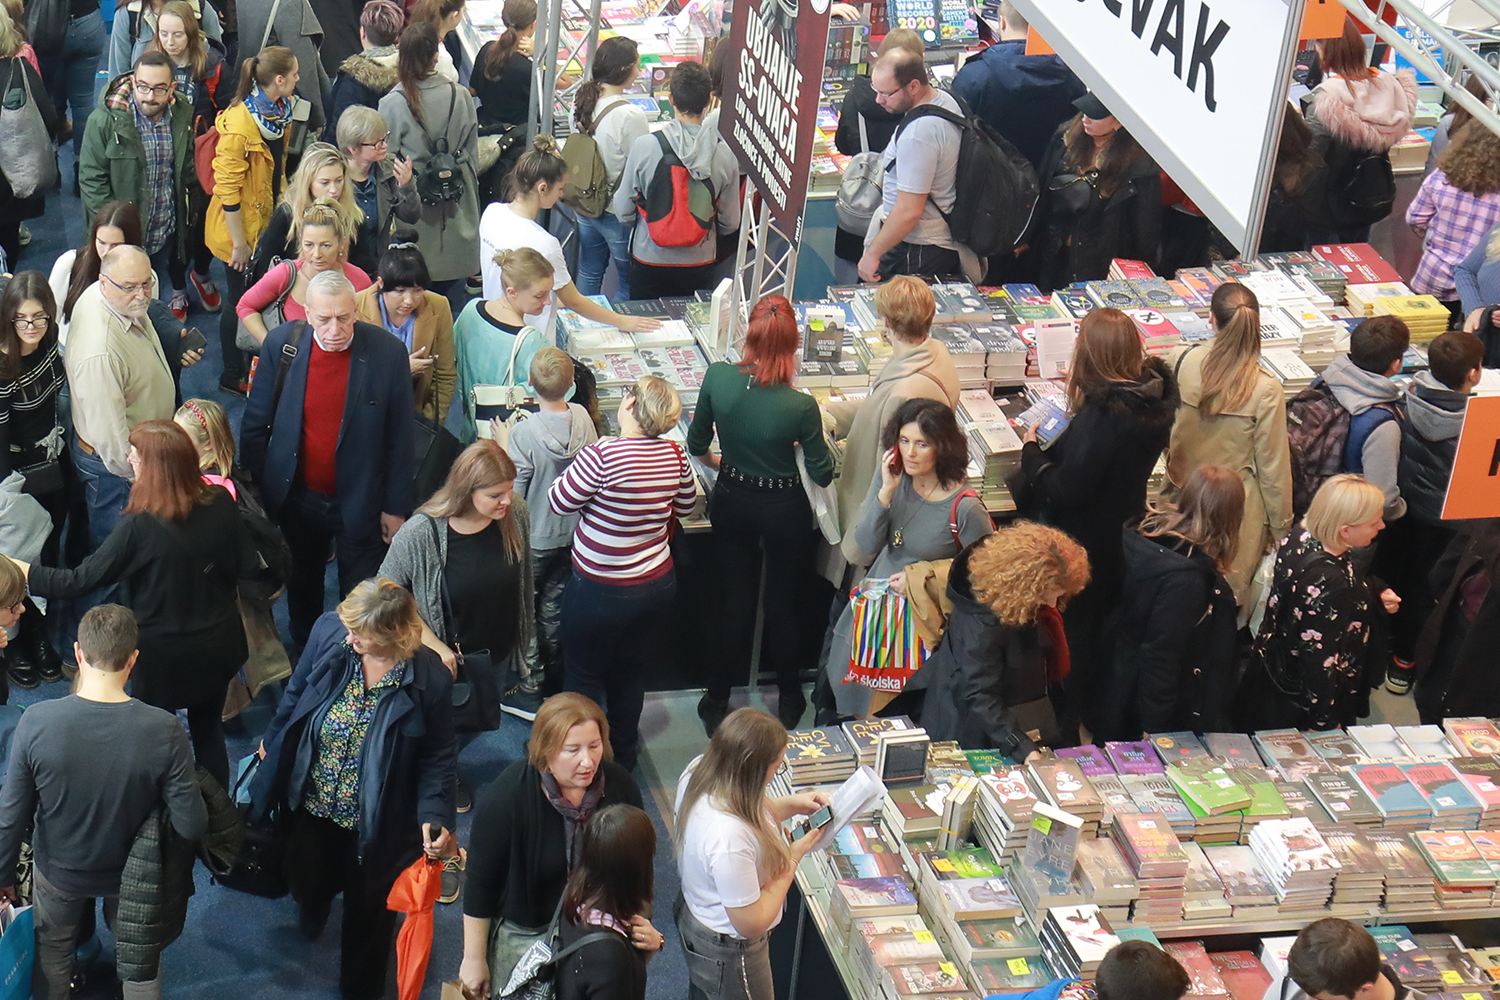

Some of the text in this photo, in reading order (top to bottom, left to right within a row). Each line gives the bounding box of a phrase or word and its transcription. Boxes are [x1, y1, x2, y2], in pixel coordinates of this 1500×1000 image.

[895, 2, 934, 11] WORLD
[896, 10, 935, 18] RECORDS
[897, 17, 936, 31] 2020
[745, 5, 803, 116] UBIJANJE
[738, 47, 798, 165] SS-OVACA
[735, 92, 746, 119] LOV
[774, 147, 794, 190] RATNE
[733, 119, 758, 168] ZLOČINCE
[761, 165, 788, 212] POVIJESTI
[946, 340, 971, 351] drugi
[986, 339, 1013, 350] drugi
[860, 675, 901, 690] školska
[1029, 832, 1075, 856] JANE
[1026, 845, 1069, 871] EYRE
[1080, 852, 1122, 867] JANE
[1087, 865, 1129, 879] EYRE
